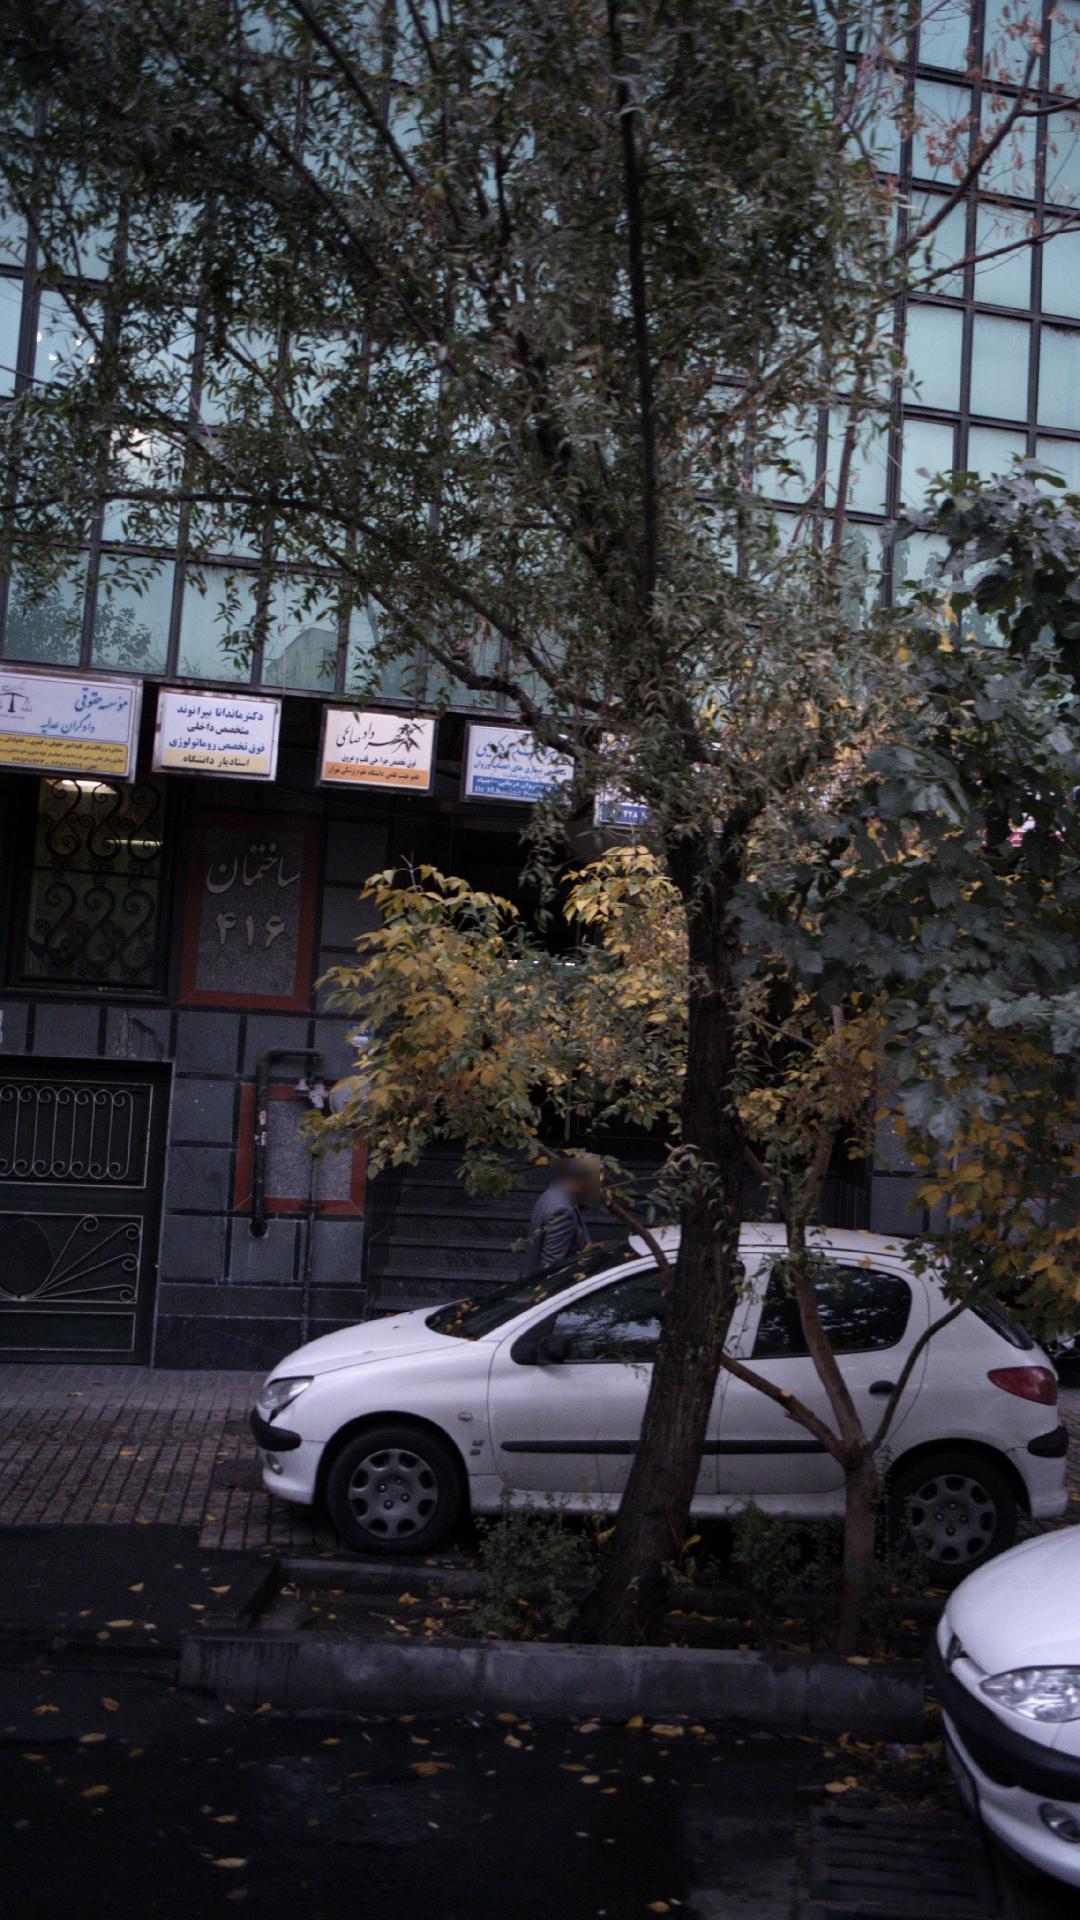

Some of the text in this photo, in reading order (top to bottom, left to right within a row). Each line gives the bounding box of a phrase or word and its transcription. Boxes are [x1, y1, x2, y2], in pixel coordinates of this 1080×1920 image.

[74, 687, 102, 712] حقوقی
[177, 704, 264, 722] دکتر ماندانا بیرانوند
[40, 713, 95, 734] دادگران عدلیه
[187, 722, 249, 735] متخصص داخلی
[169, 737, 265, 754] فوق تخصص روماتولوژی
[183, 755, 250, 768] استادیار دانشگاه
[206, 842, 300, 894] ساختمان
[216, 911, 286, 948] ۴۱۶
